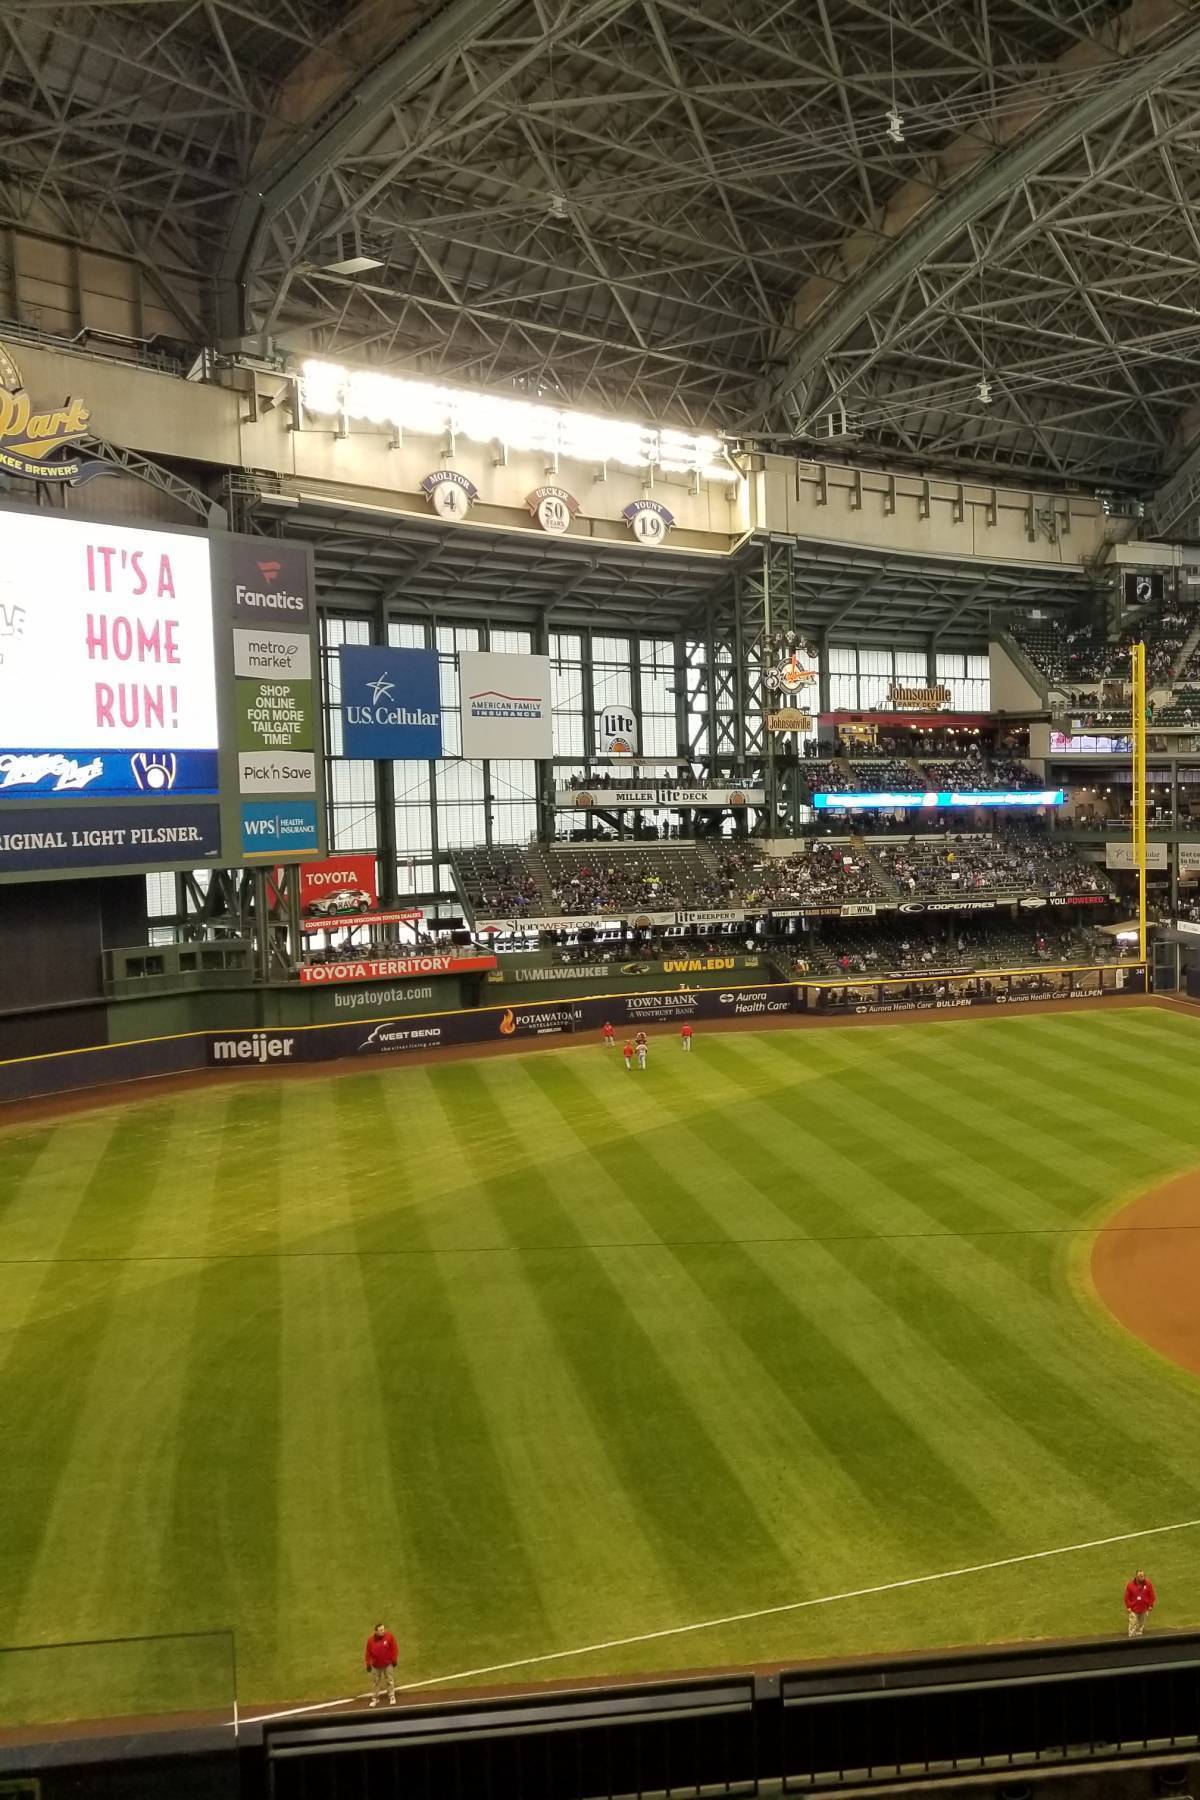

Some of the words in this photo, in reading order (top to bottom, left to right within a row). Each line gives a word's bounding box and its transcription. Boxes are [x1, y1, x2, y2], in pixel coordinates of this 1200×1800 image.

[0, 387, 92, 438] Park
[25, 463, 79, 478] BREWERS
[430, 471, 471, 490] MOLITOR
[535, 487, 569, 501] UECKER
[443, 491, 456, 512] 4
[634, 502, 663, 513] YOUNT
[545, 502, 563, 519] 50
[640, 517, 660, 537] 19
[86, 544, 149, 596] IT'S
[157, 553, 176, 599] A
[235, 584, 304, 610] Fanatics
[86, 613, 181, 664] HOME
[248, 641, 286, 655] metro
[248, 656, 292, 668] market
[259, 684, 290, 697] SHOP
[885, 683, 952, 701] Johnsonville
[95, 682, 179, 729] RUN!
[255, 697, 296, 710] ONLINE
[471, 701, 512, 711] AMERICAN
[513, 702, 541, 711] FAMILY
[247, 709, 270, 721] FOR
[272, 709, 304, 722] MORE
[346, 706, 375, 725] U.S.
[375, 708, 439, 727] Cellular
[251, 721, 301, 734] TAILGATE
[603, 714, 634, 737] Lite
[769, 716, 812, 730] Johnsonville
[262, 733, 292, 745] TIME!
[282, 766, 311, 779] Save
[616, 793, 653, 801] MILLER
[682, 792, 708, 801] DECK
[244, 819, 275, 835] WPS
[280, 818, 304, 827] HEALTH
[280, 825, 315, 834] INSURANCE
[71, 829, 126, 846] LIGHT
[131, 826, 203, 844] PILSNER.
[306, 872, 358, 886] TOYOTA
[305, 920, 331, 928] COURTESY
[382, 915, 400, 923] TOYOTA
[400, 913, 421, 921] DEALERS
[697, 913, 729, 921] BEERPEN
[304, 965, 366, 981] TOYOTA
[369, 957, 451, 976] TERRITORY
[663, 959, 735, 972] UWM.EDU
[334, 986, 432, 1007] buyatoyota.com
[626, 997, 662, 1007] TOWN
[664, 995, 698, 1006] BANK
[737, 993, 767, 1001] Aurora
[1008, 995, 1029, 1004] Aurora
[1031, 994, 1051, 1002] Health
[1070, 990, 1103, 999] BULLPEN
[636, 1009, 673, 1017] WINTRUST
[736, 1001, 765, 1013] Health
[767, 1002, 787, 1010] Care
[869, 1003, 891, 1013] Aurora
[893, 1002, 914, 1011] Health
[936, 1000, 972, 1009] BULLPEN
[379, 1031, 409, 1041] WEST
[411, 1028, 441, 1037] BEND
[214, 1034, 294, 1063] meijer
